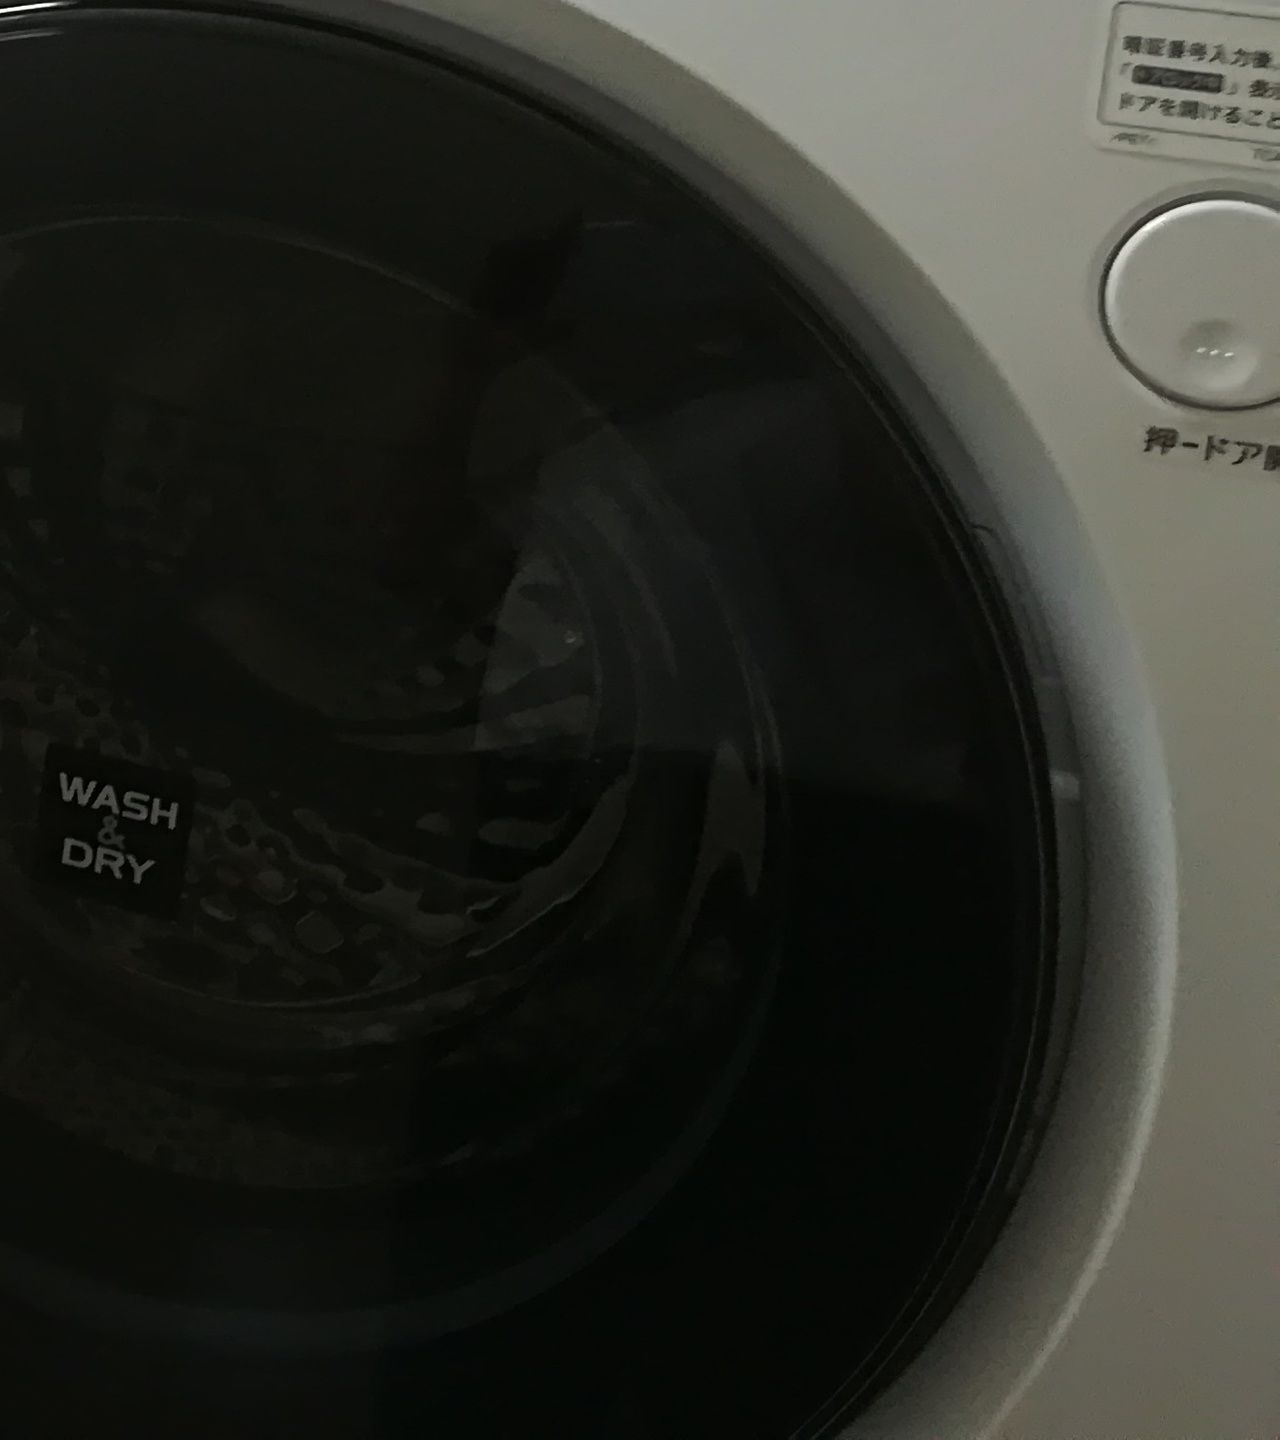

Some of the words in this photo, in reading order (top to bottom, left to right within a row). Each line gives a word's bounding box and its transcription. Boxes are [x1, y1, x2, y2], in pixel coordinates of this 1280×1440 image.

[58, 771, 180, 831] WASH
[97, 814, 126, 850] &
[60, 837, 157, 886] DRY
